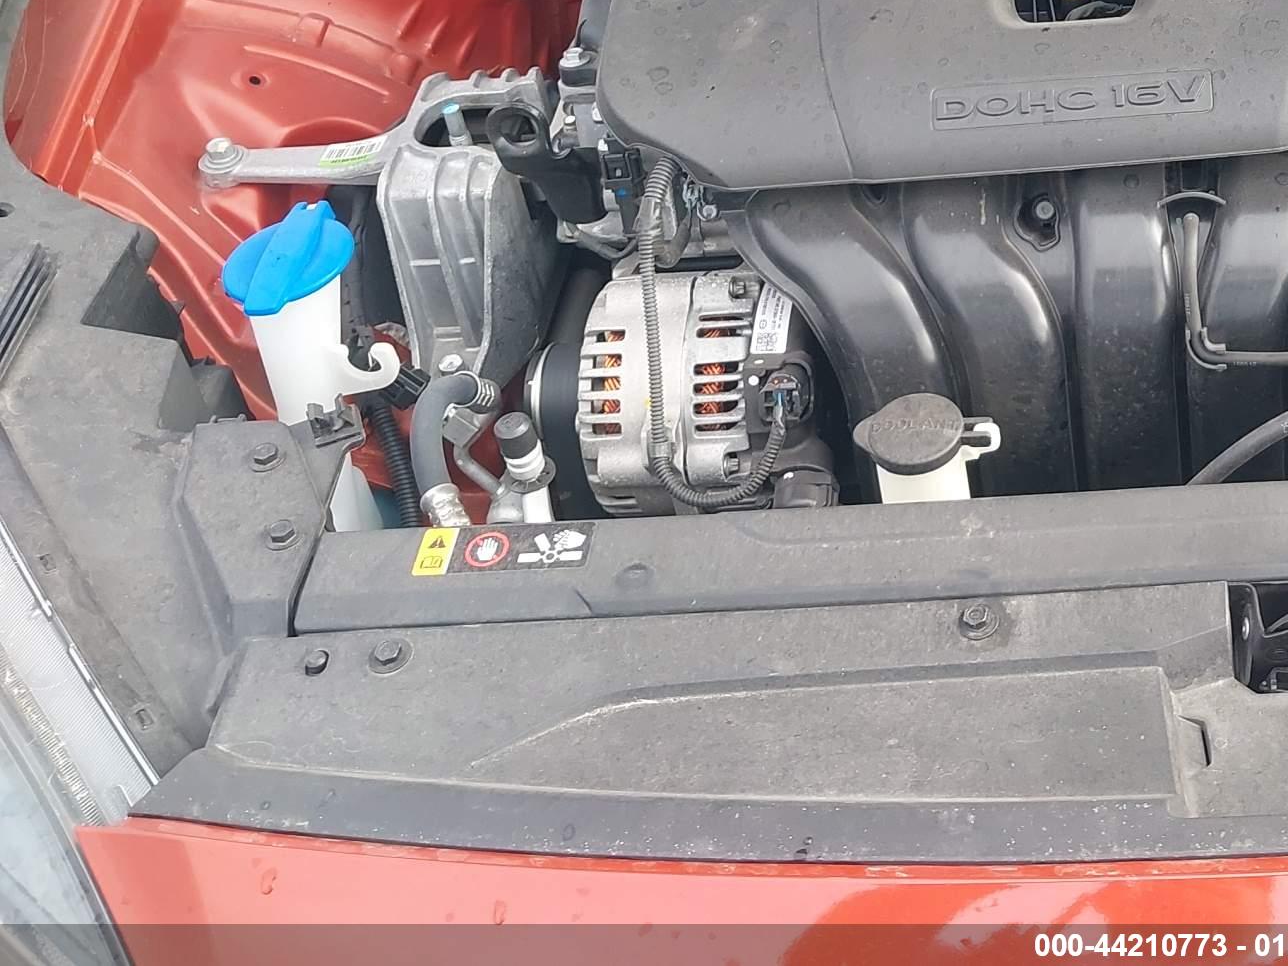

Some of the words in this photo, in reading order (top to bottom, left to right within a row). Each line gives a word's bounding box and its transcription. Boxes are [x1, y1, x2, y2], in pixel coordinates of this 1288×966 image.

[935, 88, 1097, 122] DOHC
[1111, 75, 1206, 109] 16V
[871, 417, 961, 436] COOLANT
